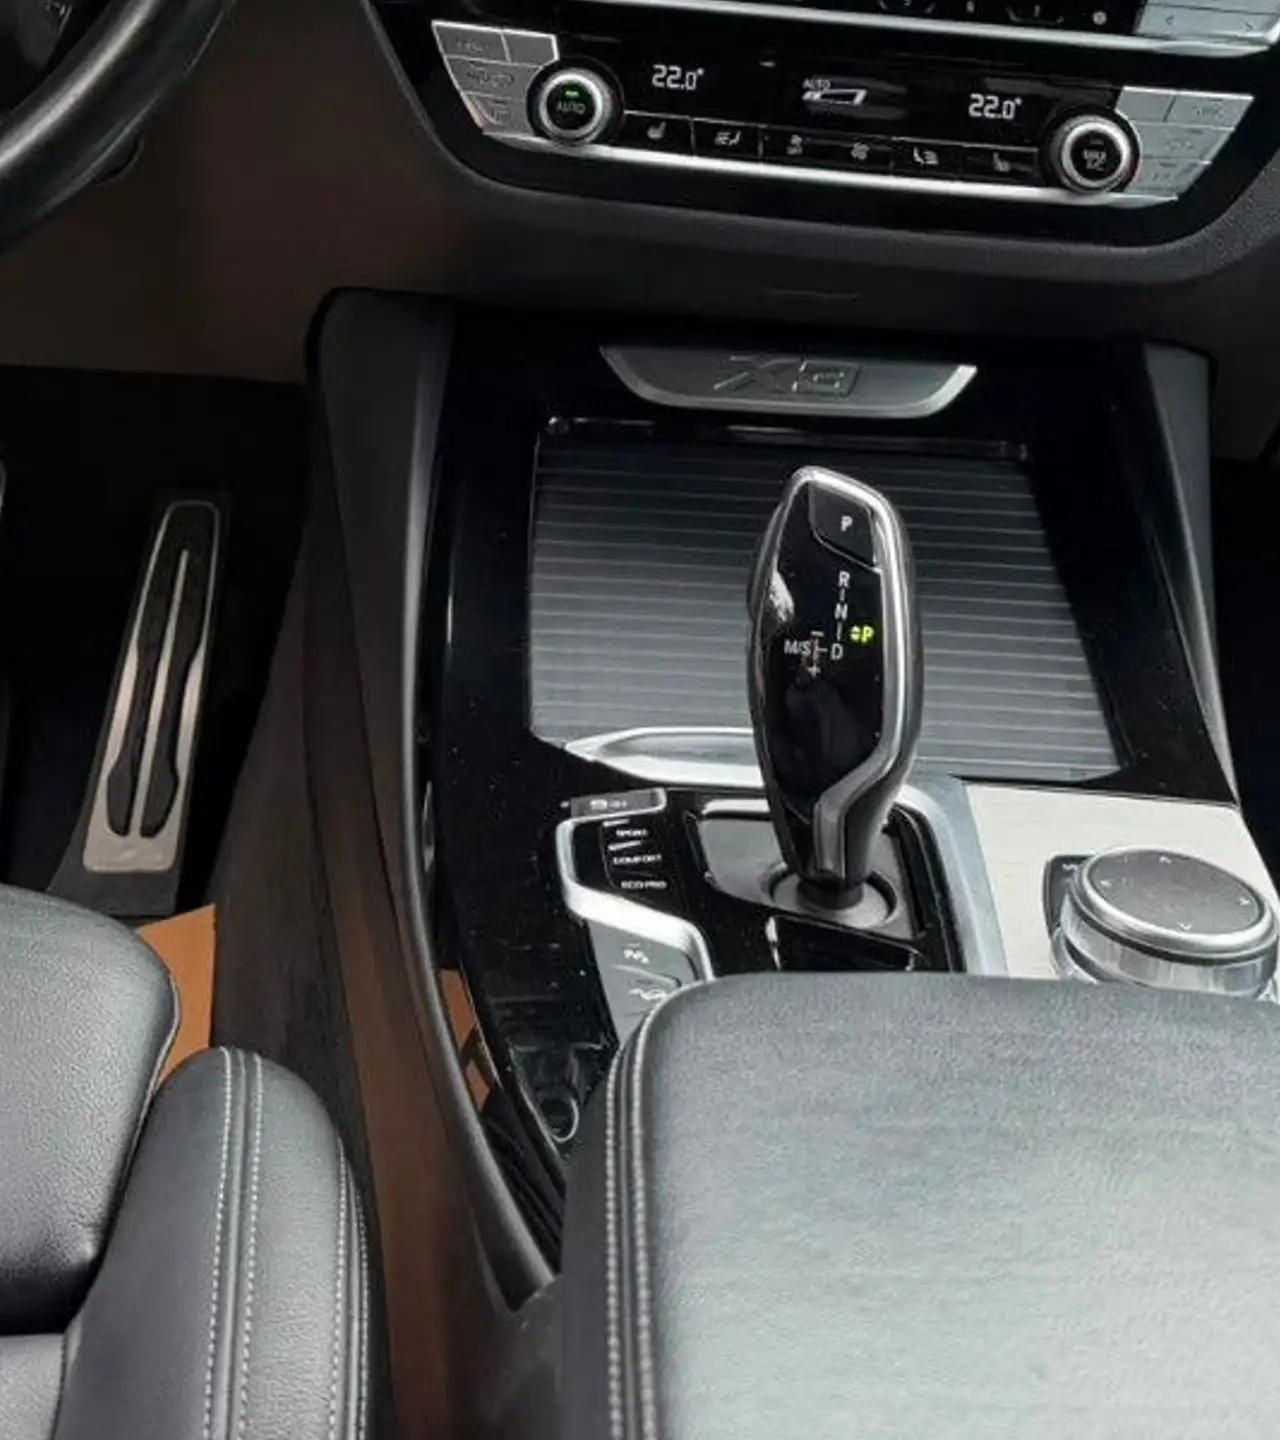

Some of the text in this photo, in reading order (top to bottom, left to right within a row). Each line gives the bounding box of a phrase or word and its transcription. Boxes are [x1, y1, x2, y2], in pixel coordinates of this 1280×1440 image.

[841, 515, 853, 532] P
[838, 570, 851, 589] R
[784, 639, 811, 655] M/S
[830, 643, 844, 660] D
